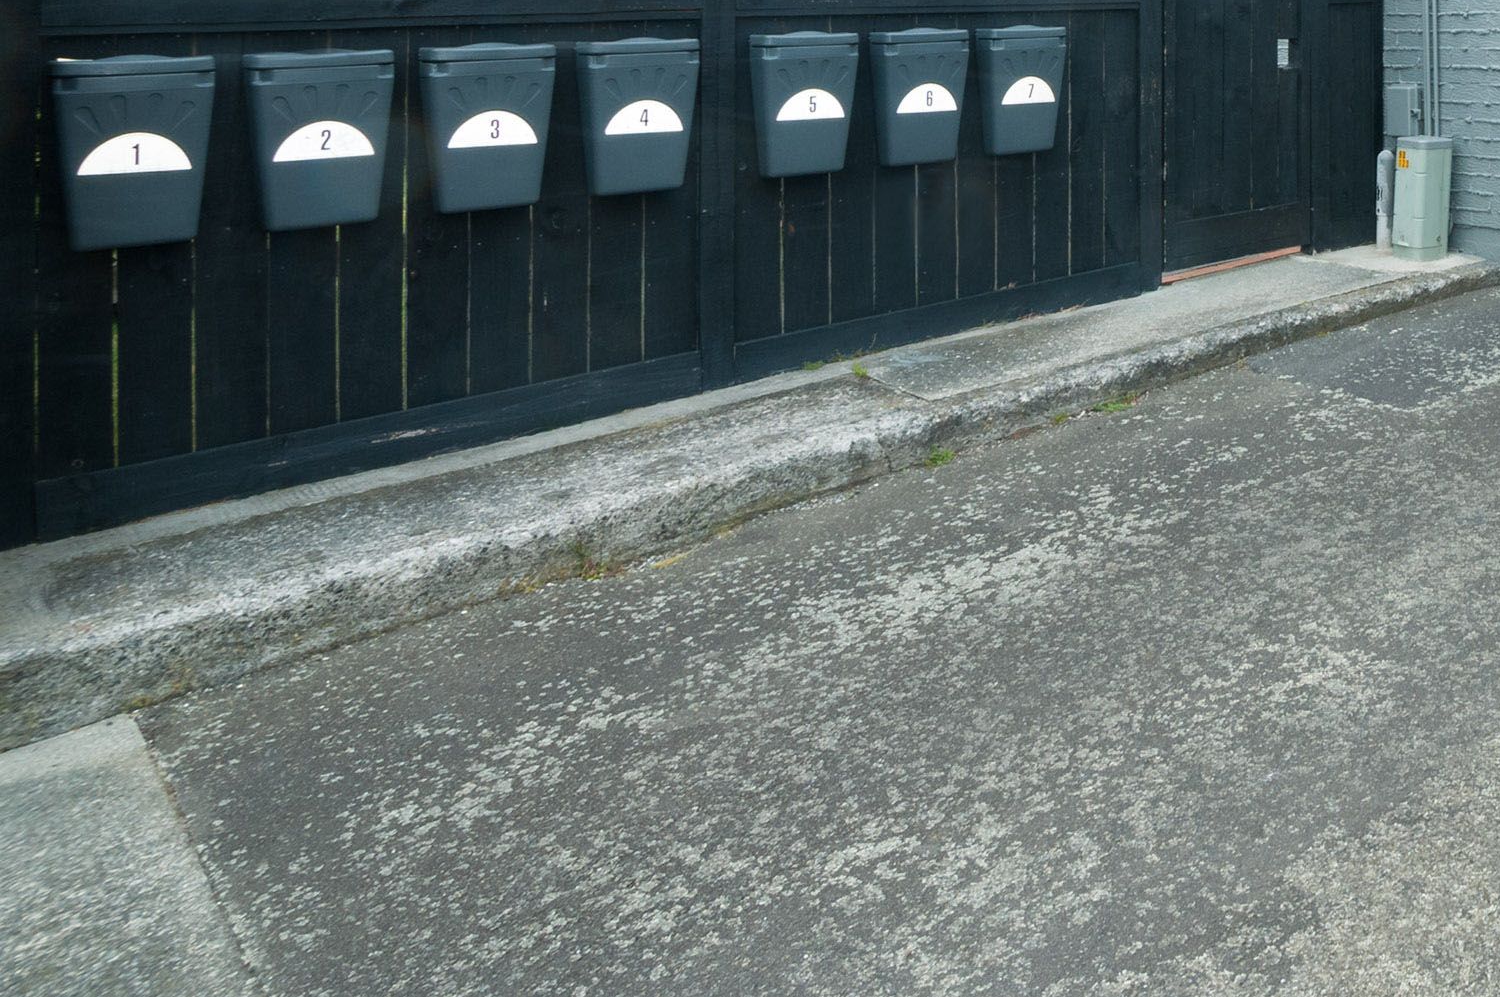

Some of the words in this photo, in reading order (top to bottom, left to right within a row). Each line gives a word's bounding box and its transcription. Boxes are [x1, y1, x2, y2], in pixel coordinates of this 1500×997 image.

[926, 91, 933, 106] 6
[1029, 83, 1035, 98] 7
[809, 95, 817, 113] 5
[640, 109, 649, 127] 4
[490, 119, 500, 140] 3
[320, 129, 331, 151] 2
[132, 144, 140, 166] 1
